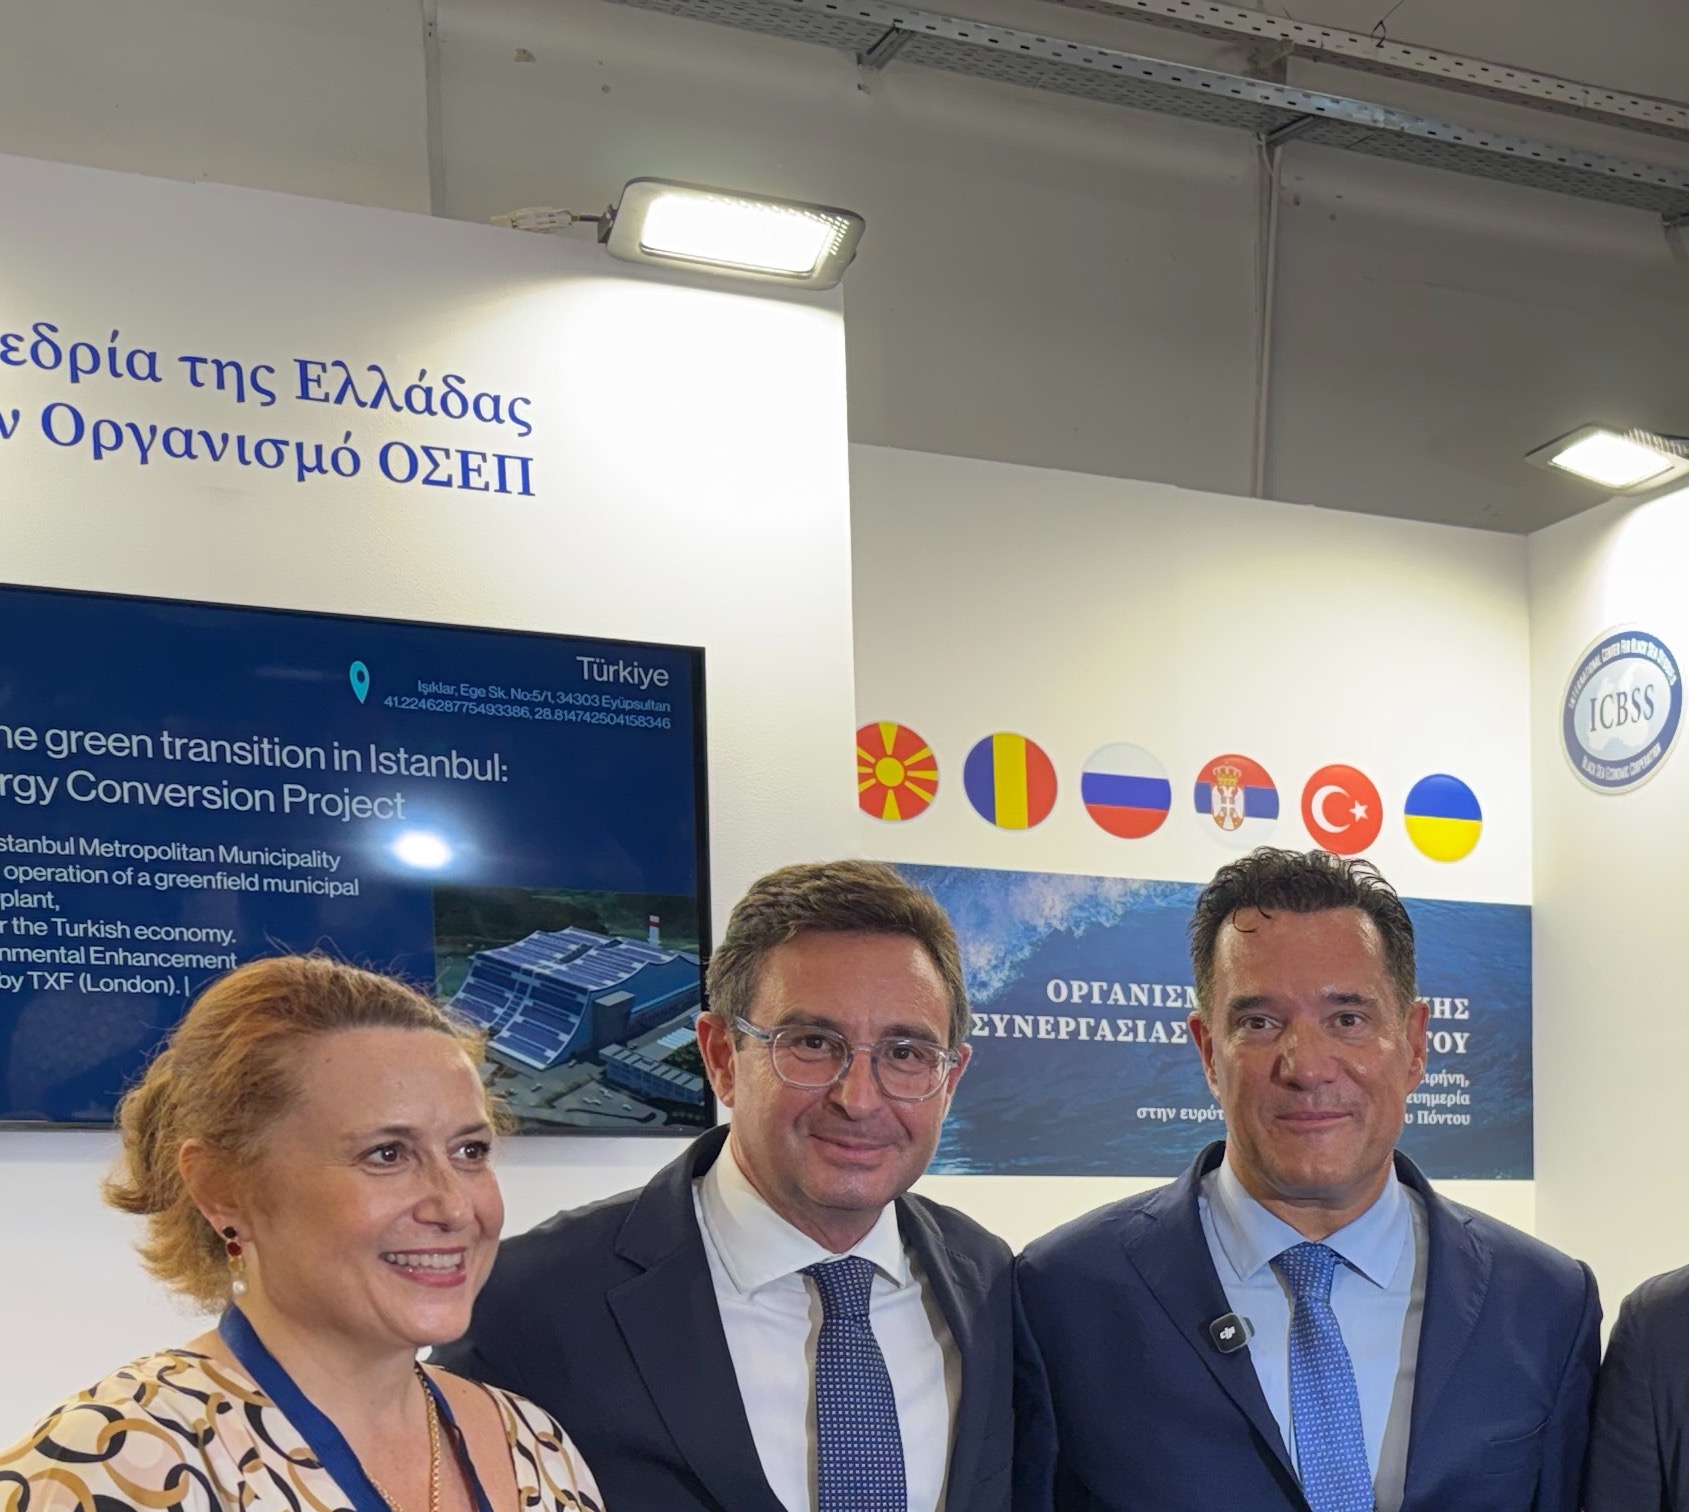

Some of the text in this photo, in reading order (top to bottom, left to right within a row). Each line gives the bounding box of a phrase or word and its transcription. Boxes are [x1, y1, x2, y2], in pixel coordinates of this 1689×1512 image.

[0, 322, 532, 437] εδρία της Ελλάδας
[41, 402, 361, 482] Οργανισμό
[379, 441, 535, 496] ΟΣΕΠ
[576, 656, 670, 690] Türkiye
[460, 683, 486, 700] Ege
[488, 686, 508, 700] Sk.
[556, 691, 599, 706] 34303
[602, 695, 670, 714] Eyüpsultan
[1590, 684, 1655, 732] ICBSS
[45, 728, 153, 759] green
[160, 730, 327, 771] transition
[333, 741, 362, 772] in
[370, 743, 508, 783] Istanbul:
[0, 769, 406, 823] rgy Conversion Project
[0, 834, 340, 872] stanbul Metropolitan Municipality
[4, 864, 360, 898] operation of a greenfield municipal
[0, 889, 60, 912] plant,
[11, 917, 48, 937] the
[51, 918, 131, 940] Turkish
[134, 927, 237, 946] economy.
[0, 946, 238, 970] nmental Enhancement
[27, 971, 74, 991] TXF
[79, 972, 180, 996] (London).
[971, 1013, 1188, 1044] ΣΥΝΕΡΓΑΣΙΑΣ
[1420, 1069, 1470, 1088] ιρήνη,
[1136, 1106, 1176, 1122] στην
[1417, 1109, 1471, 1125] Πόντου
